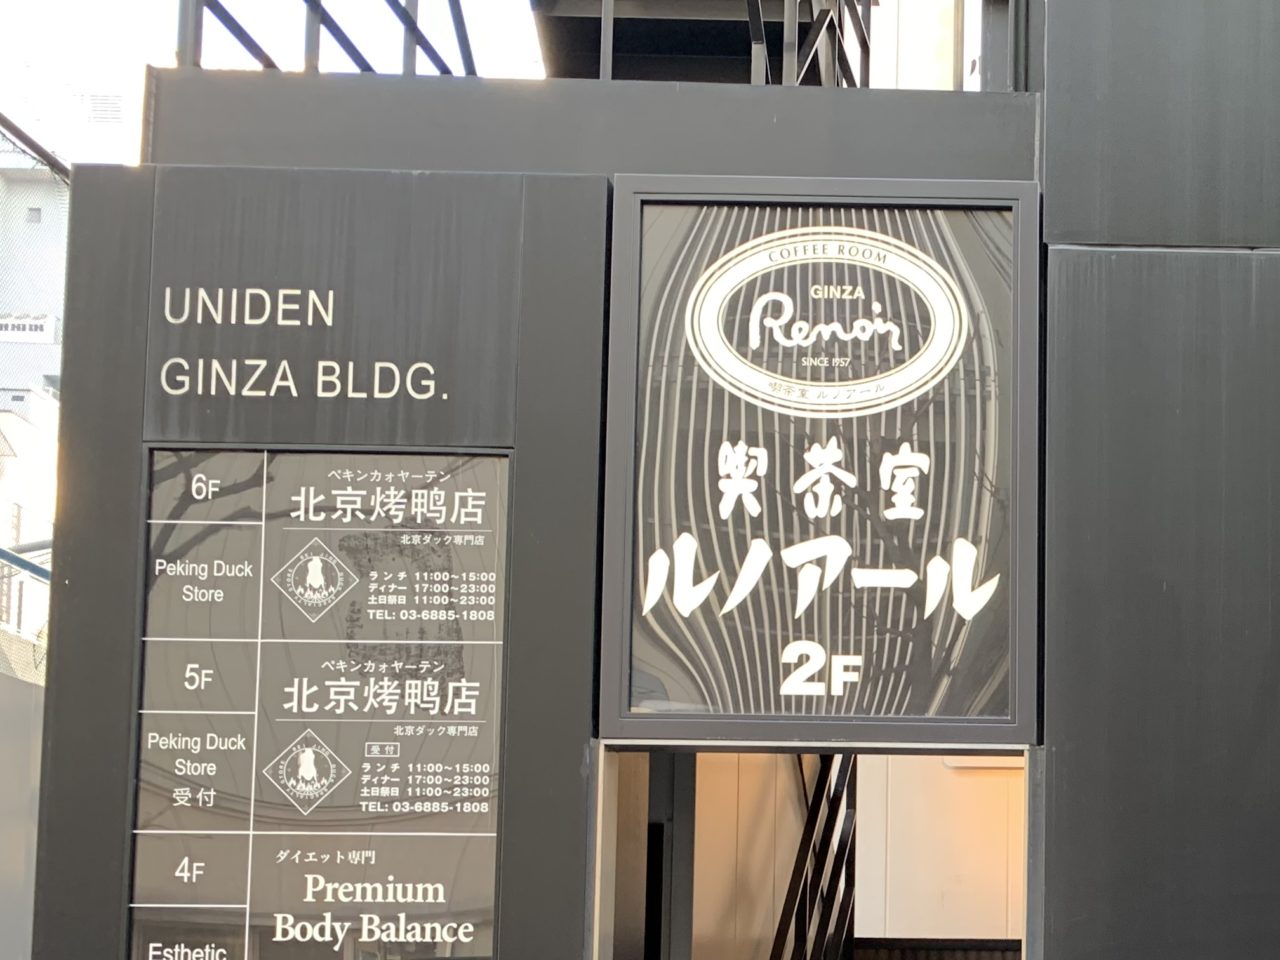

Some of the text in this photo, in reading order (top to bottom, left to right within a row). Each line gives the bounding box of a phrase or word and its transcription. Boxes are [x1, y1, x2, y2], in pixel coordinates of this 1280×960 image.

[768, 243, 888, 265] COFFEE ROOM
[810, 285, 865, 299] GINZA
[163, 287, 335, 327] UNIDEN
[750, 291, 902, 350] Renoir
[801, 357, 851, 367] SINCE 1957
[161, 357, 449, 400] GINZA BLDG.
[191, 474, 220, 500] 6F
[718, 435, 931, 520] 喫茶室
[290, 486, 486, 525] 北京烤鸭店
[400, 534, 484, 546] 北京ダック専門店
[155, 560, 252, 580] Peking Duck
[642, 531, 1000, 621] ルノアール
[182, 586, 224, 601] Store
[368, 583, 407, 593] ディナー
[367, 610, 495, 621] TEL: 03-6885-1808
[184, 664, 213, 690] 5F
[780, 639, 863, 696] 2F
[283, 677, 480, 715] 北京烤鸭店
[394, 725, 478, 736] 北京ダック専門店
[148, 733, 246, 753] Peking Duck
[175, 760, 216, 775] Store
[361, 775, 400, 784] ディナー
[173, 788, 216, 807] 受付
[360, 802, 489, 813] TEL: 03-6885-1808
[275, 850, 376, 865] ダイエット専門
[175, 857, 205, 882] 4F
[303, 874, 446, 903] Premium
[272, 912, 474, 951] Body Balance
